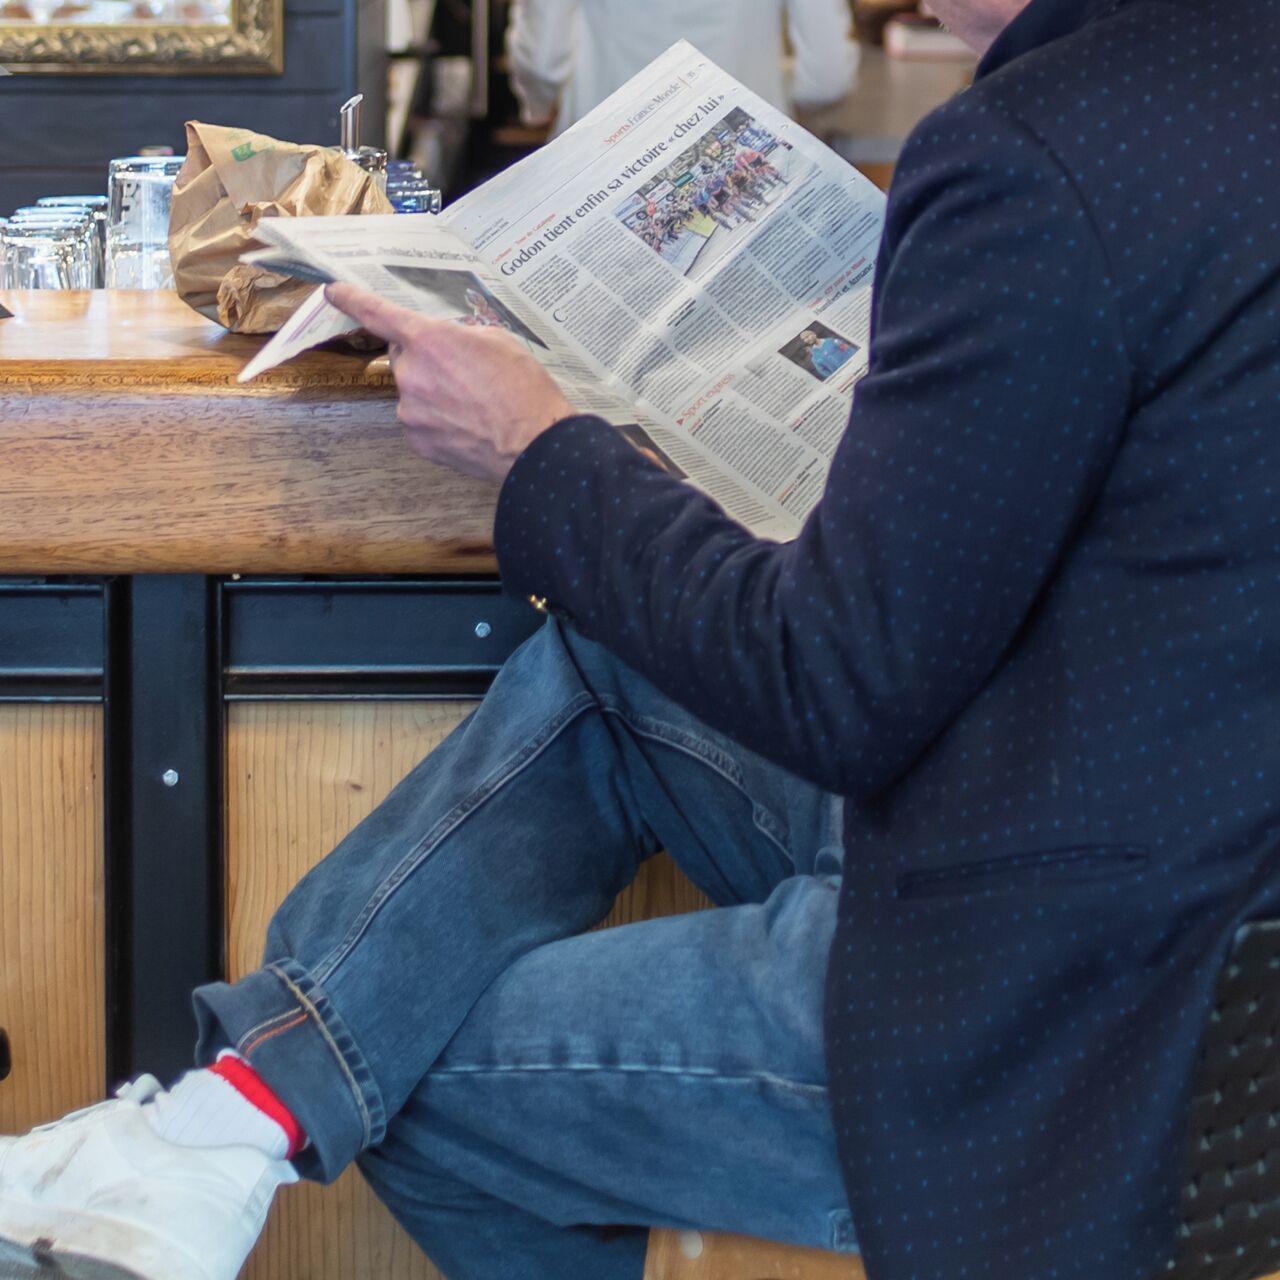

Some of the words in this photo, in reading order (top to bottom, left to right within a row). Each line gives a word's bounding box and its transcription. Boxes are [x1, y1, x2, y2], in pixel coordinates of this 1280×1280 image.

[603, 123, 632, 146] Sports
[500, 239, 547, 276] Godon
[543, 215, 577, 242] tient
[574, 189, 610, 218] enfin
[606, 178, 625, 193] sa
[620, 142, 669, 180] victoire
[682, 397, 708, 420] Sport
[705, 373, 736, 399] express
